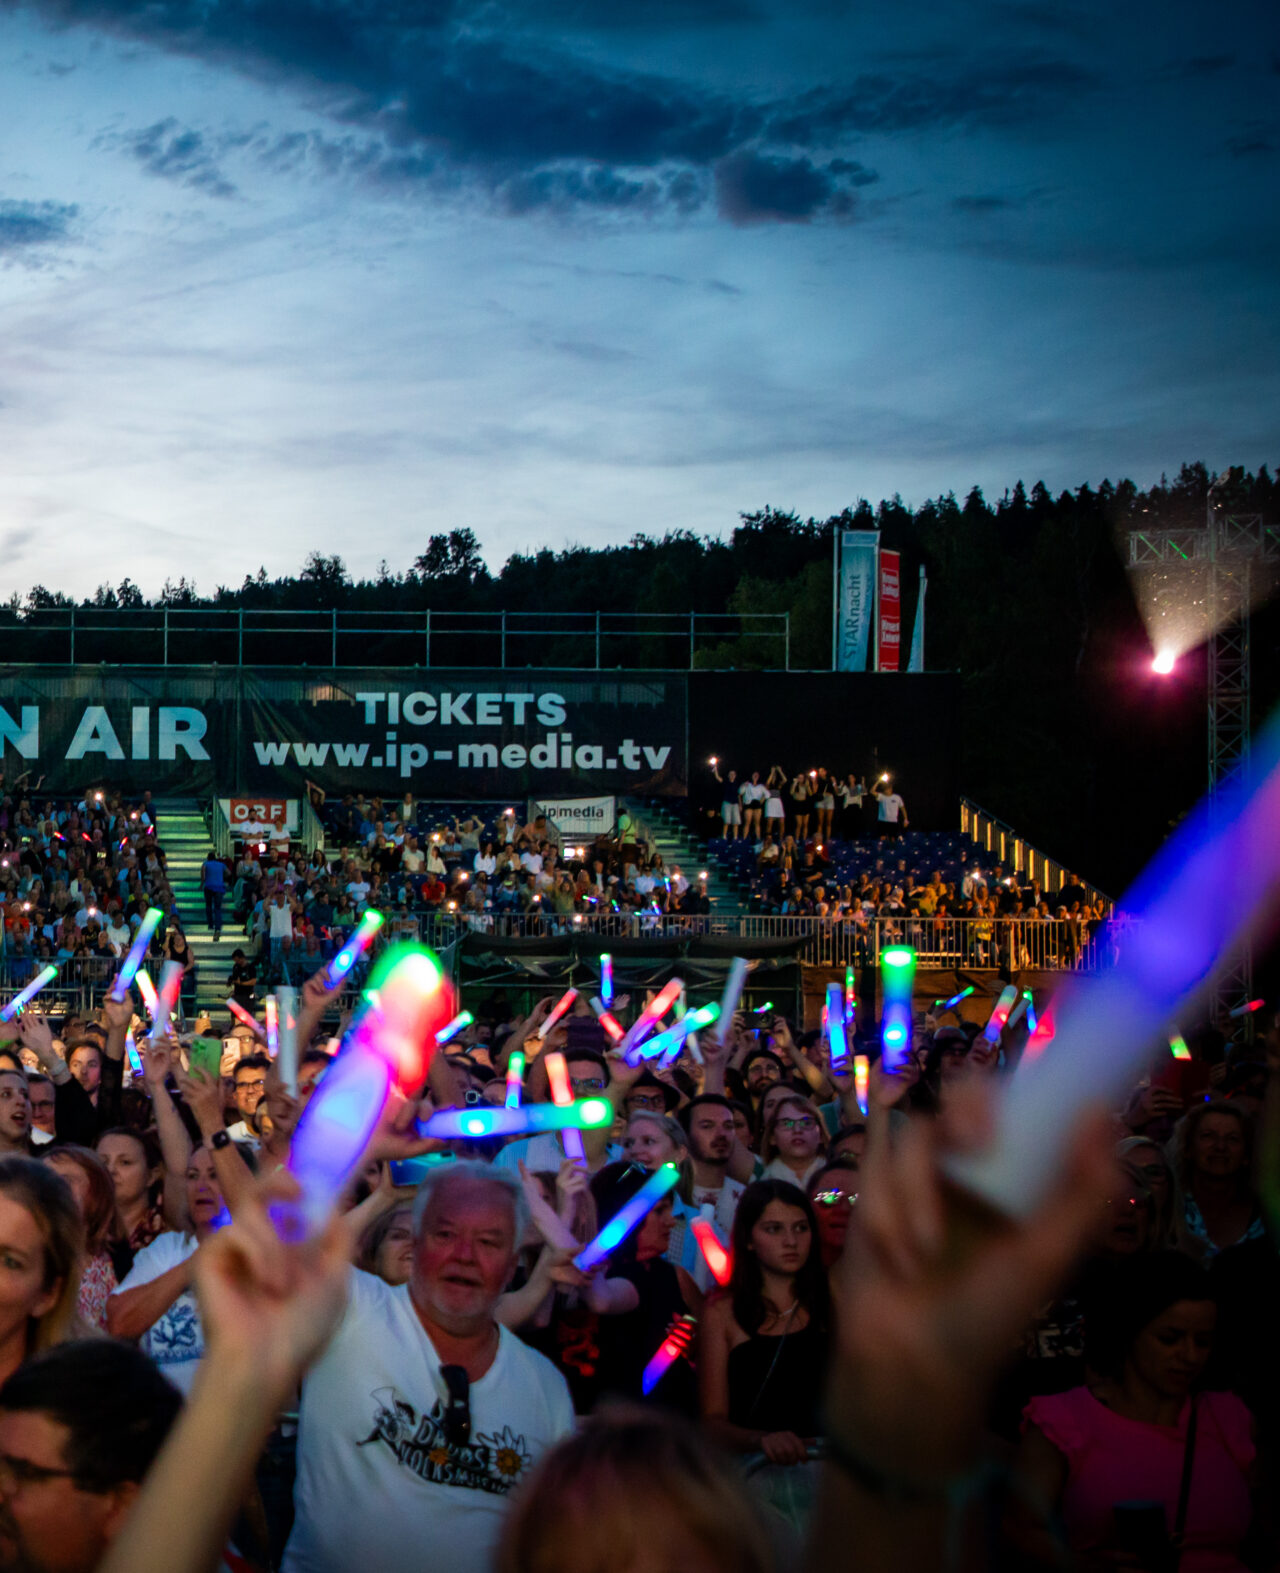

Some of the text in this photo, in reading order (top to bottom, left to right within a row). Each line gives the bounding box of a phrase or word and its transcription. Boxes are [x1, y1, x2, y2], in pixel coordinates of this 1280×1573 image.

[355, 691, 567, 725] TICKETS
[64, 705, 211, 761] AIR
[253, 731, 672, 778] www.ip-media.tv
[234, 804, 283, 820] ORF
